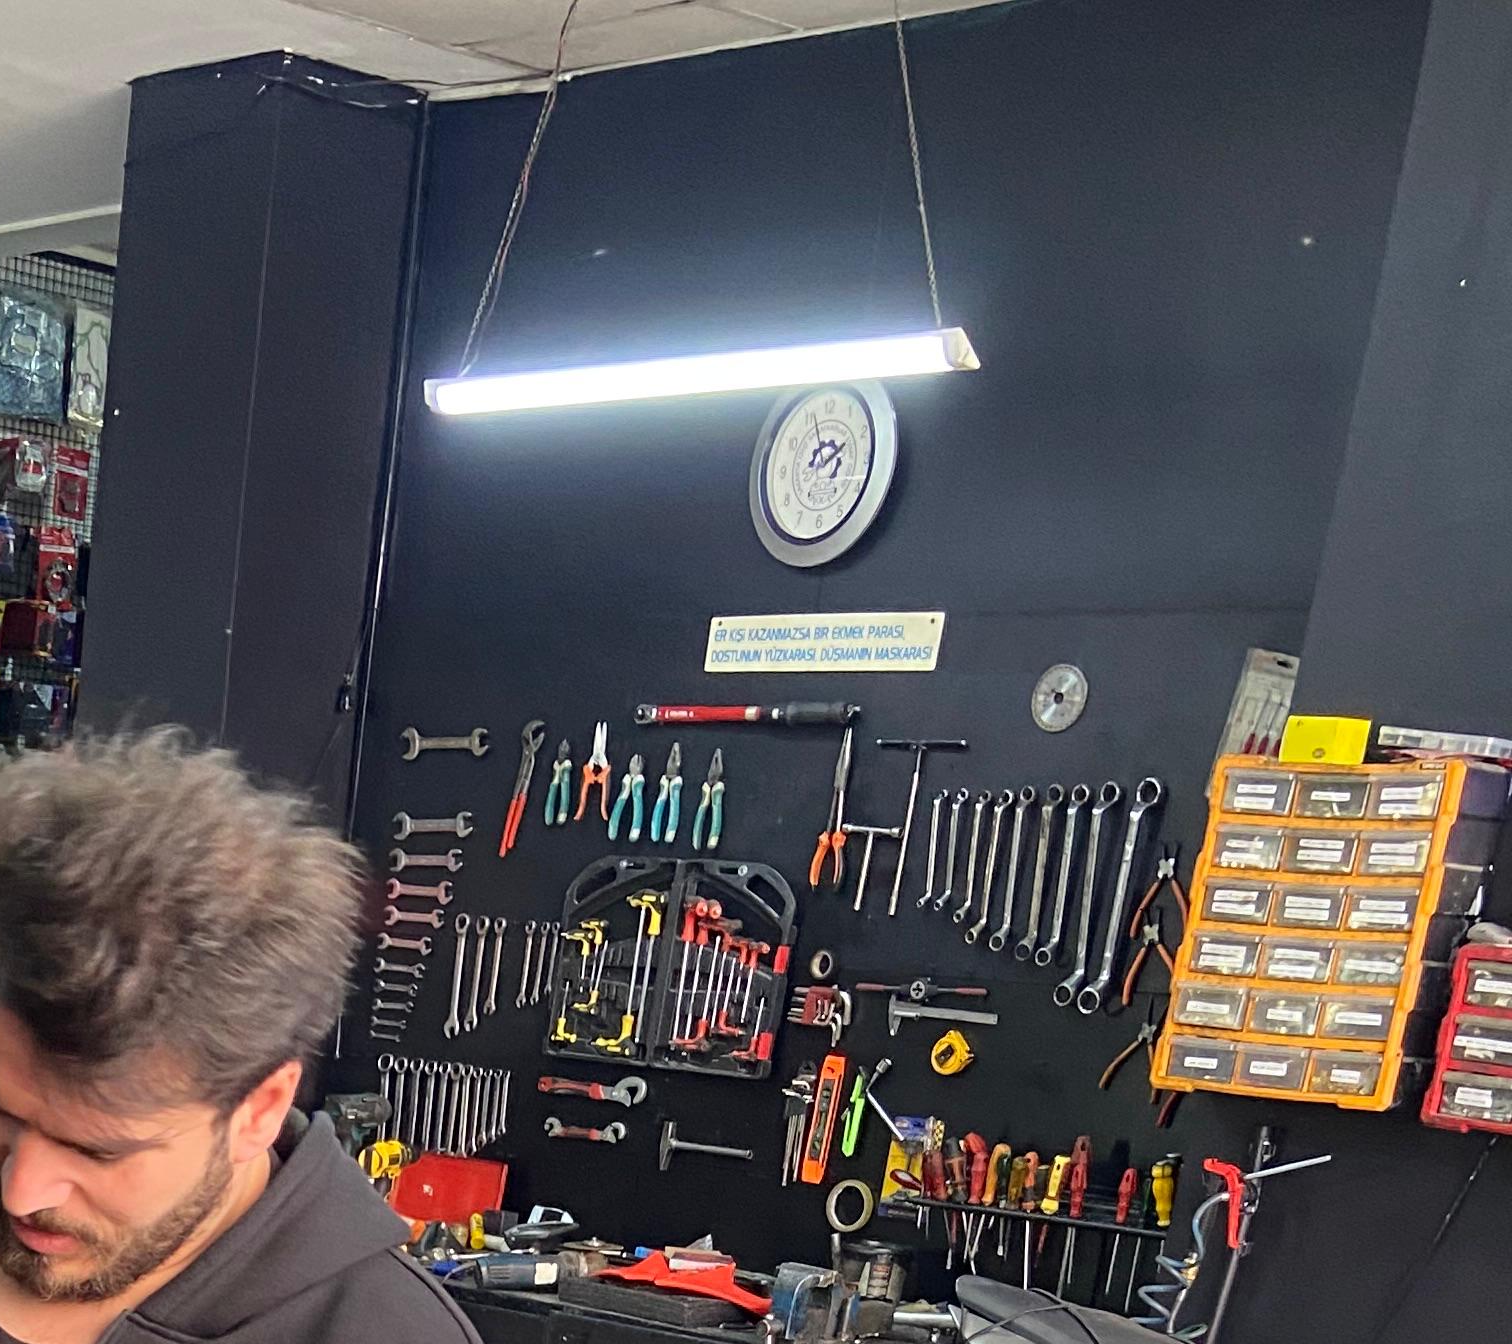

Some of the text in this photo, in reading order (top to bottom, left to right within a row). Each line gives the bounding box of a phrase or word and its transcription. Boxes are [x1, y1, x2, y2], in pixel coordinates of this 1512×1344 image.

[824, 400, 835, 414] 12
[779, 465, 787, 480] 9
[815, 513, 823, 529] 6
[714, 629, 727, 642] ER
